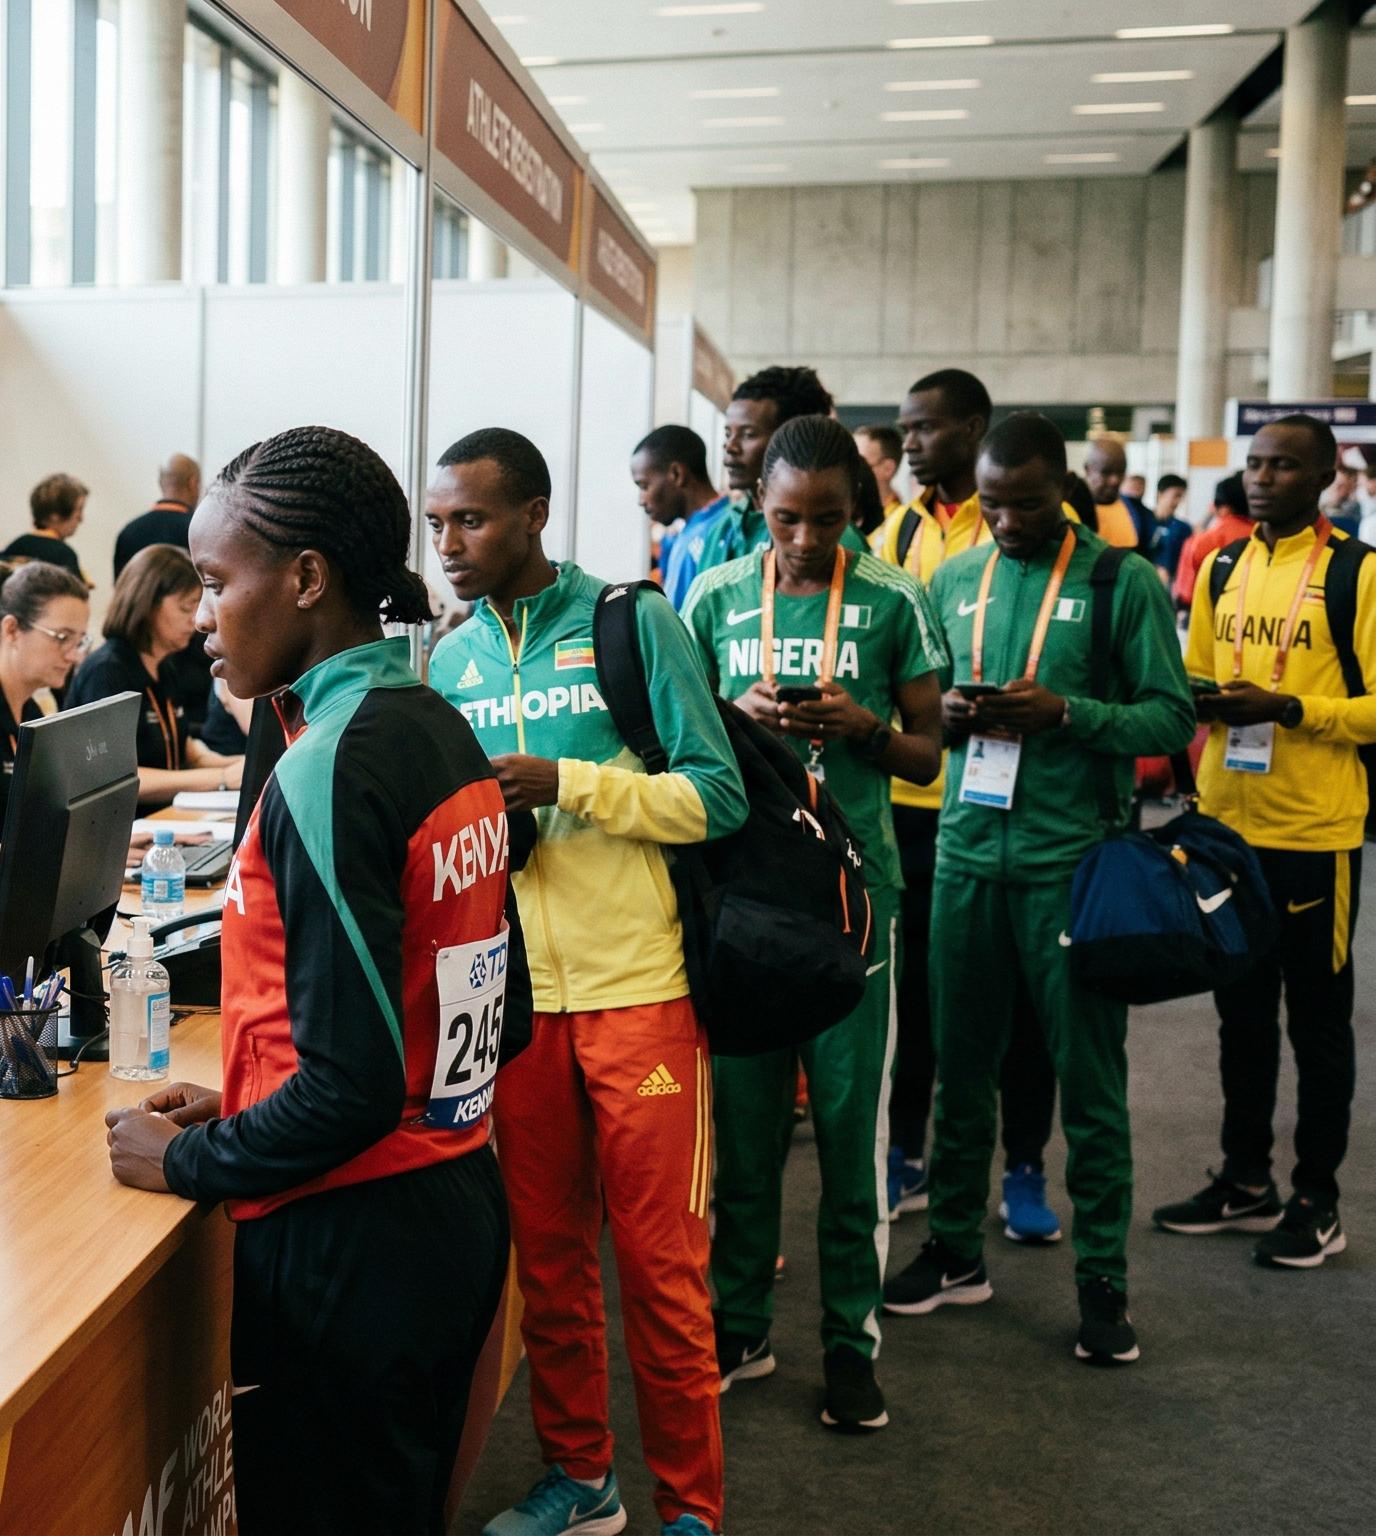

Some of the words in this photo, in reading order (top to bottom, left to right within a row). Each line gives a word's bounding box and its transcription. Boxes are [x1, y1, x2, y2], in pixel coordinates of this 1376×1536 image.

[729, 638, 859, 679] NIGERA
[458, 683, 609, 729] ETHIOPIA
[432, 811, 509, 902] KENYA
[444, 992, 503, 1086] 245
[637, 1082, 682, 1097] adidas
[112, 1448, 178, 1536] AF
